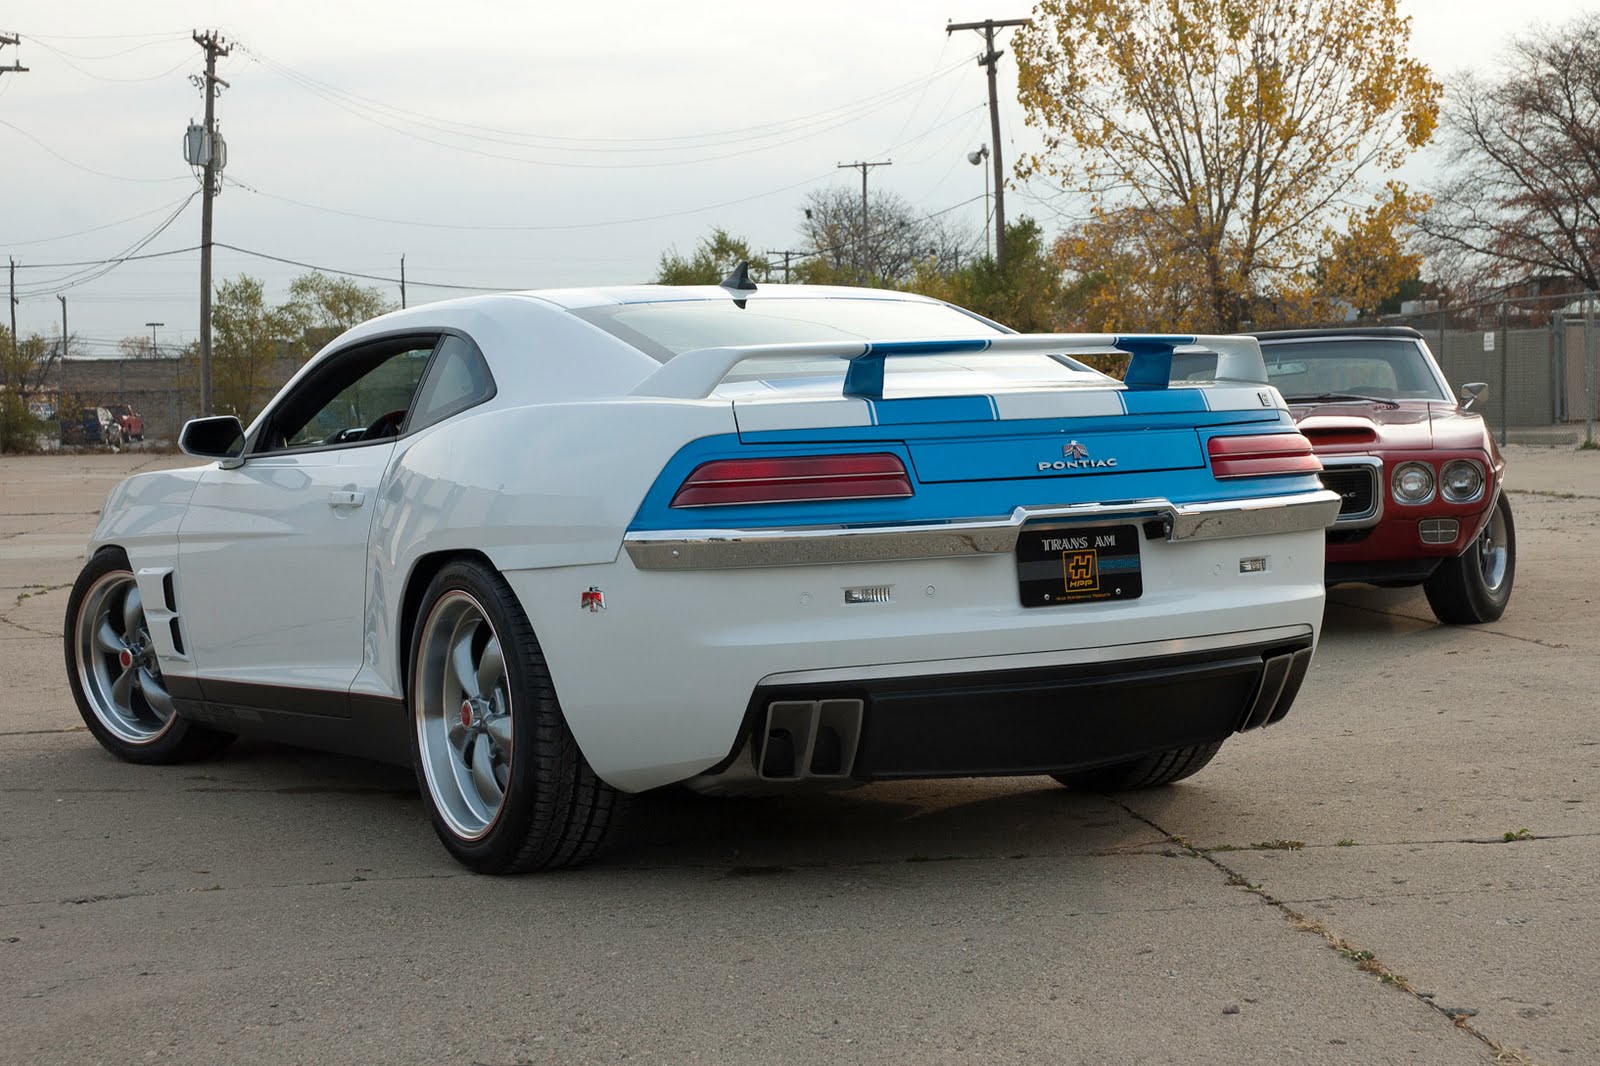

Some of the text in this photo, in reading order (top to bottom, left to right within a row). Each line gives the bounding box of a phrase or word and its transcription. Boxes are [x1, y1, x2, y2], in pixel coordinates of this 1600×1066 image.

[1038, 458, 1117, 470] PONTIAC
[1041, 535, 1115, 551] TRANS AM
[1069, 580, 1093, 588] HPP
